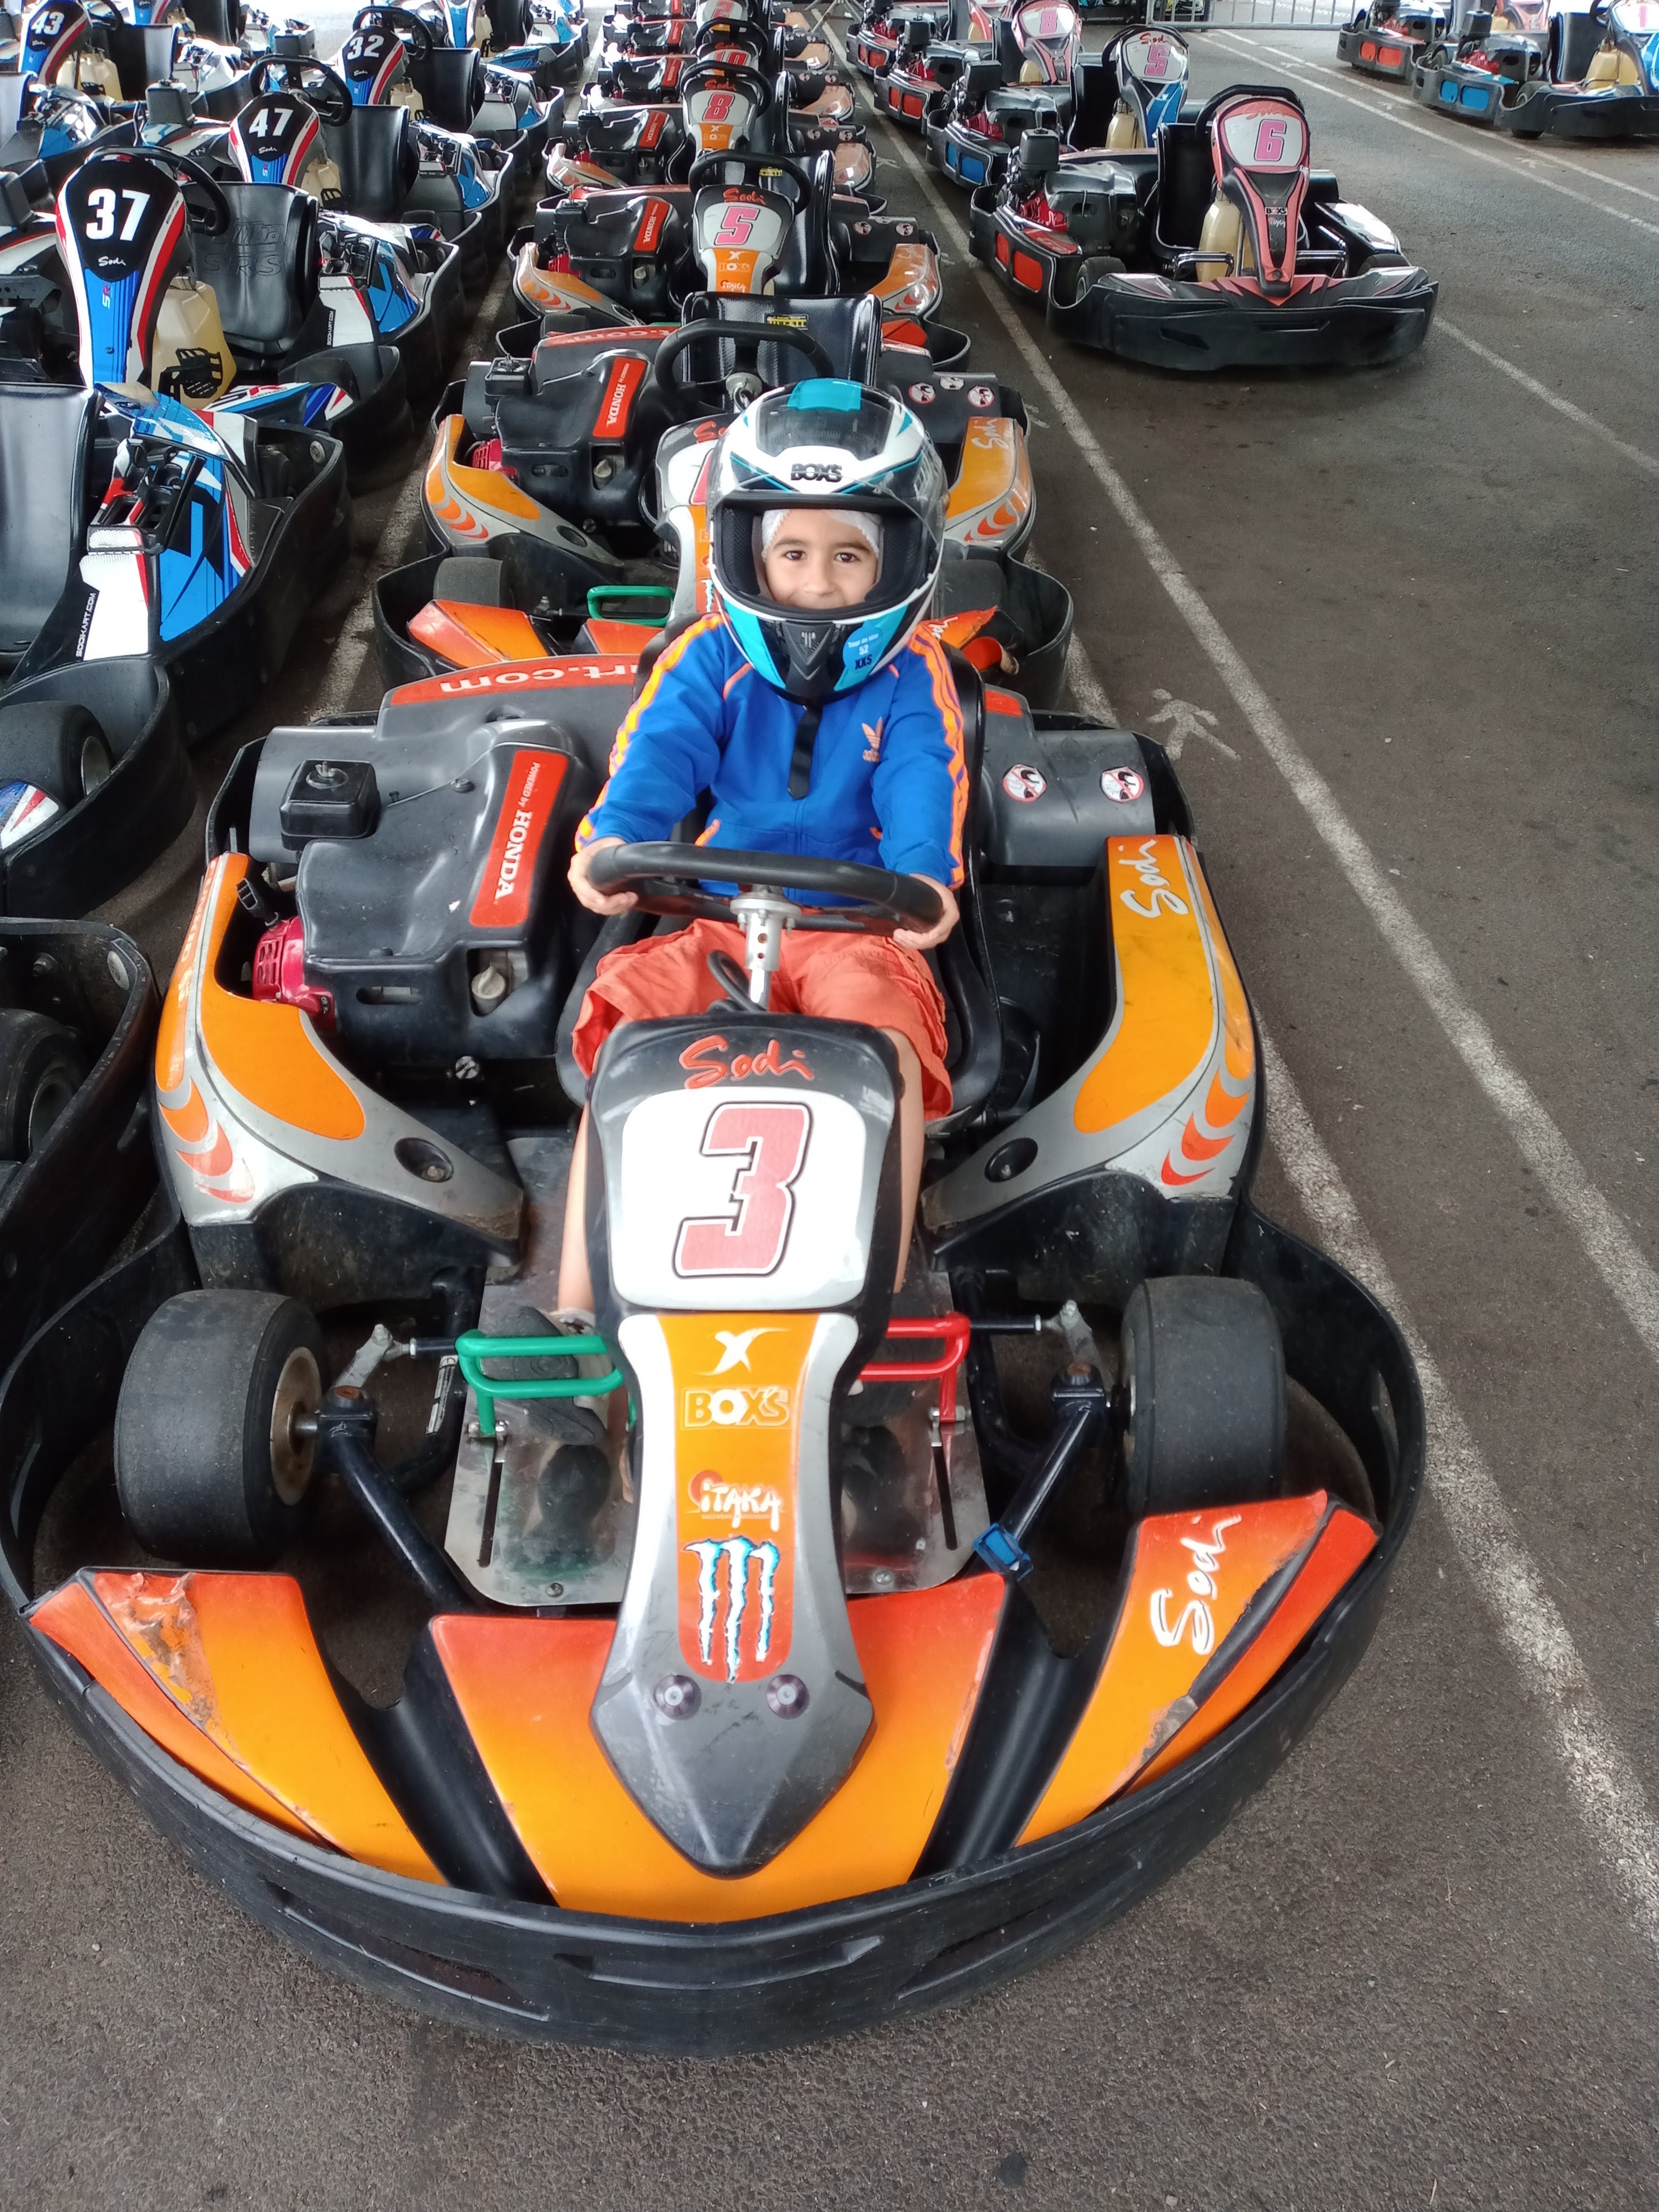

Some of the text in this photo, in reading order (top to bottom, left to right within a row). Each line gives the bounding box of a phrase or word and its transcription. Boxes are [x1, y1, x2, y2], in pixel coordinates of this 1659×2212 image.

[31, 11, 65, 35] 43
[1040, 10, 1058, 34] 8
[347, 35, 384, 60] 32
[1144, 44, 1171, 76] 5
[248, 108, 294, 138] 47
[702, 92, 736, 122] 8
[1253, 119, 1287, 162] 6
[723, 187, 767, 205] Sodi
[86, 188, 150, 242] 37
[643, 216, 657, 244] HONDA
[714, 205, 761, 246] 5
[98, 256, 127, 266] Sodi
[574, 329, 673, 342] t.com
[606, 383, 626, 426] HONDA
[76, 592, 96, 657] SODIKART.COM
[440, 664, 639, 692] rt.com
[854, 654, 873, 671] XXS
[522, 761, 541, 798] POWERED
[494, 809, 534, 901] HONDA
[1119, 839, 1189, 918] Sodi
[678, 1034, 815, 1090] Sodi
[672, 1101, 814, 1279] 3
[1150, 1514, 1242, 1655] Sodi
